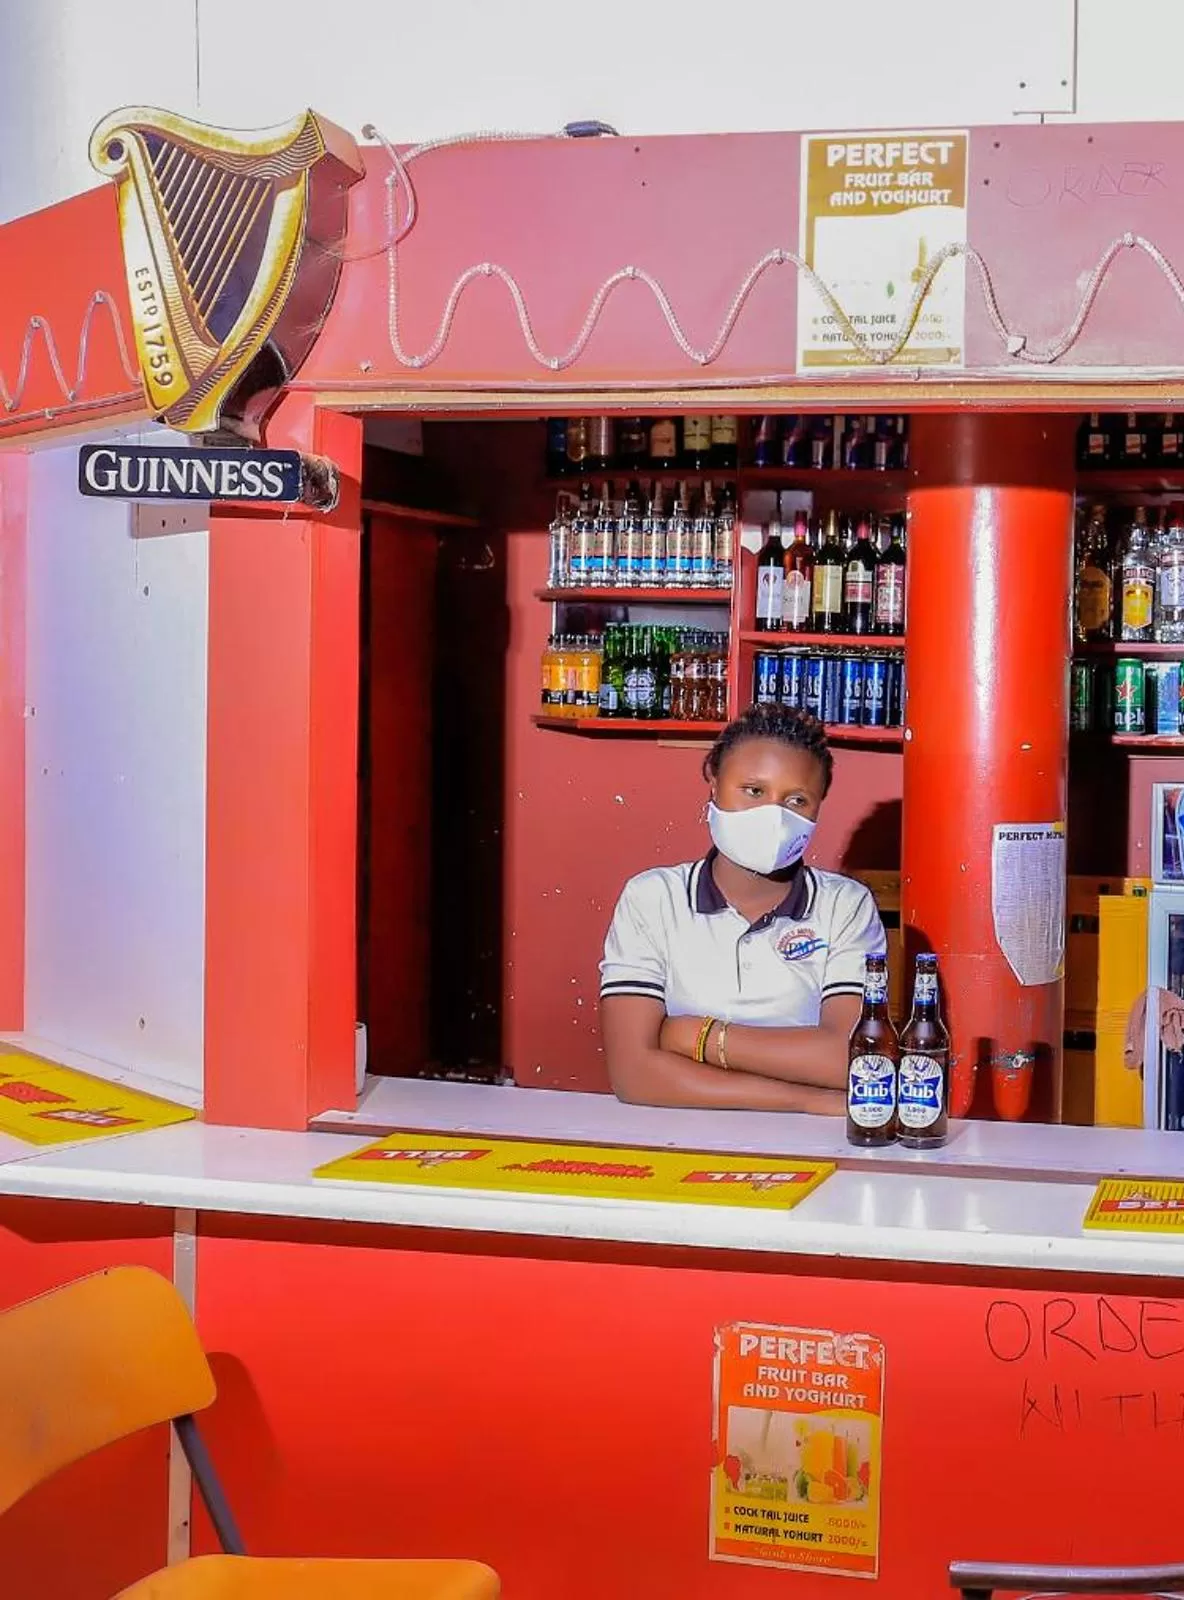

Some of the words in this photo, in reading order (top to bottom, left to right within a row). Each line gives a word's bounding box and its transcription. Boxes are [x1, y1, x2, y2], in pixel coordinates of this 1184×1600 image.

[827, 141, 954, 168] PERFECT
[844, 172, 893, 188] FRUIT
[897, 170, 934, 187] BAR
[830, 190, 866, 207] AND
[871, 189, 952, 206] YOGHURT
[143, 322, 174, 387] 1759
[85, 450, 285, 497] GUINNESS
[999, 831, 1044, 841] PERFECT
[853, 1083, 888, 1097] Club
[901, 1083, 934, 1099] Club
[379, 1150, 473, 1160] BELL
[707, 1172, 799, 1182] BELL
[739, 1333, 870, 1370] PERFECT
[757, 1366, 808, 1383] FRUIT
[812, 1373, 849, 1389] BAR
[743, 1383, 779, 1398] AND
[785, 1386, 867, 1408] YOGHURT
[760, 1508, 782, 1520] TAIL
[783, 1511, 809, 1524] JUICE
[734, 1523, 782, 1538] NATURAL
[783, 1528, 824, 1543] YOHURT
